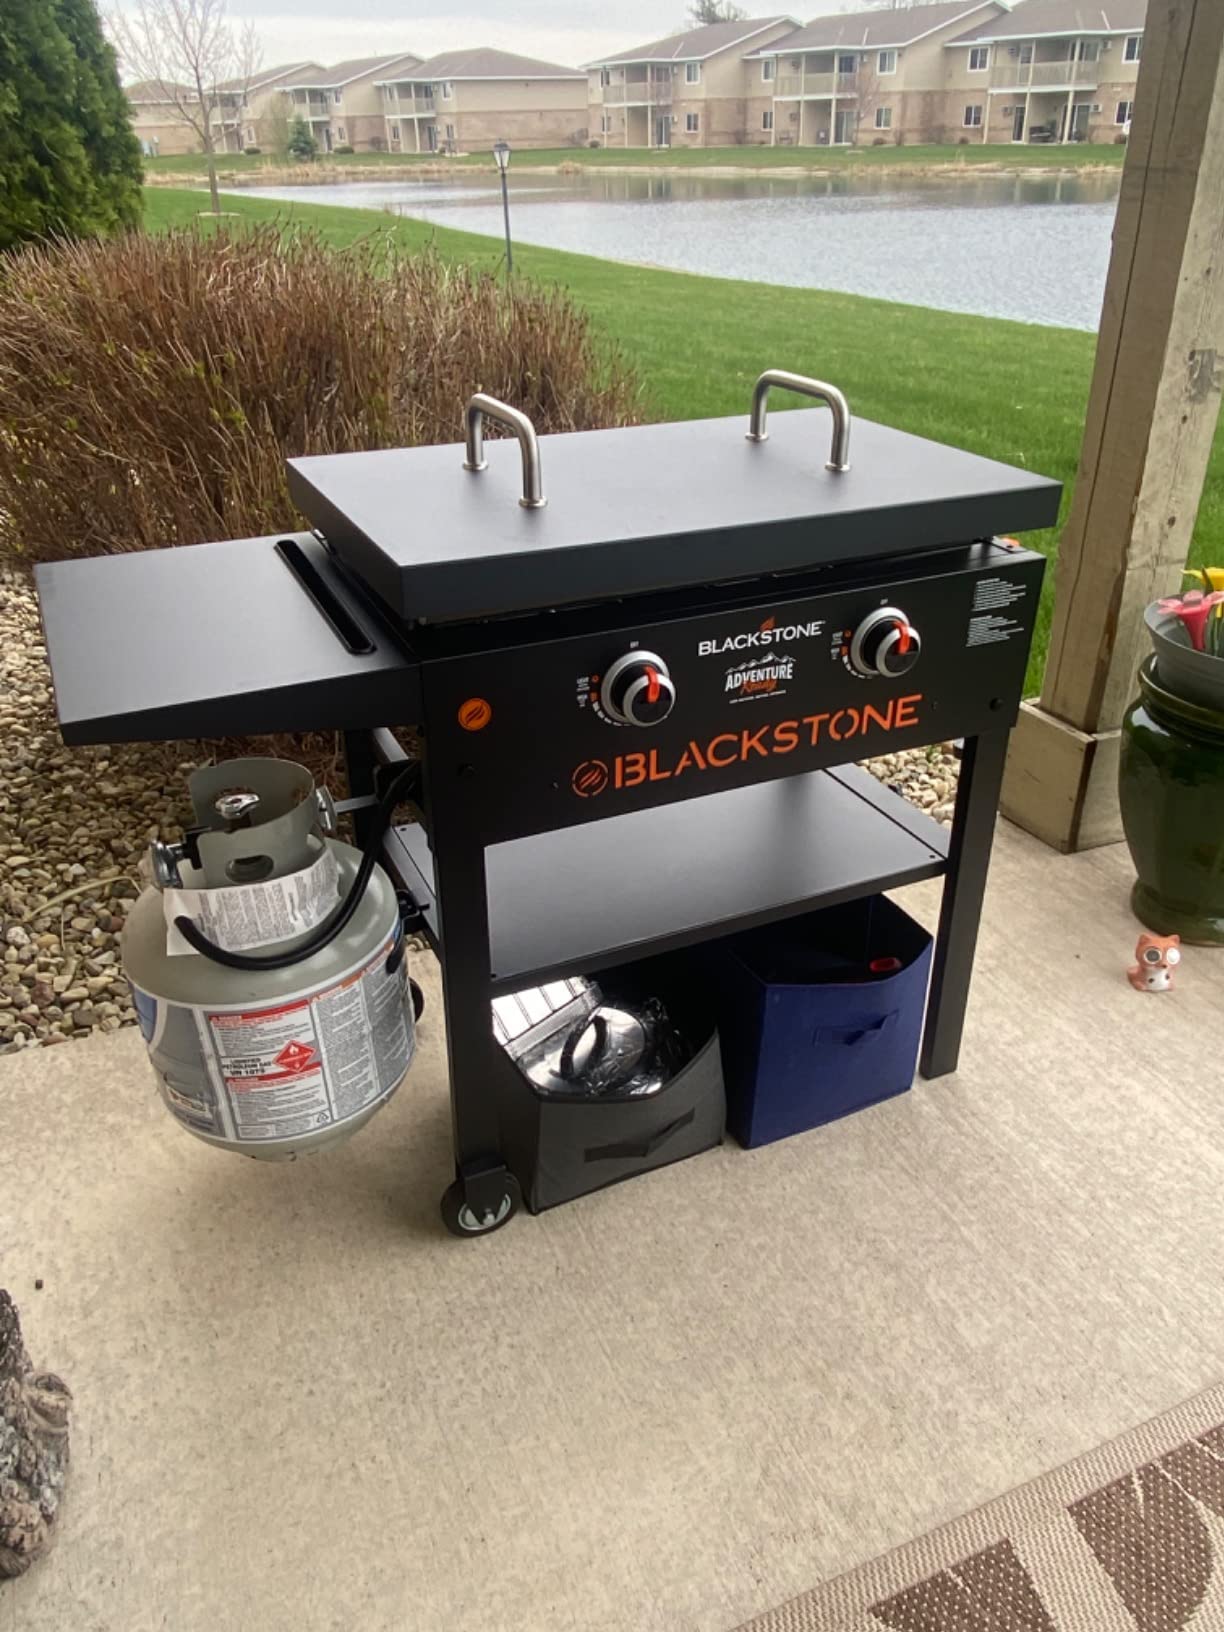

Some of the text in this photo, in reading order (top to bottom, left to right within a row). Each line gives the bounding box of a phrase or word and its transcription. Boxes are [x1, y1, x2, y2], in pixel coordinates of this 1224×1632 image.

[697, 620, 823, 656] BLACKSTONE
[724, 662, 793, 692] ADVENTURE
[614, 693, 923, 789] BLACKSTONE
